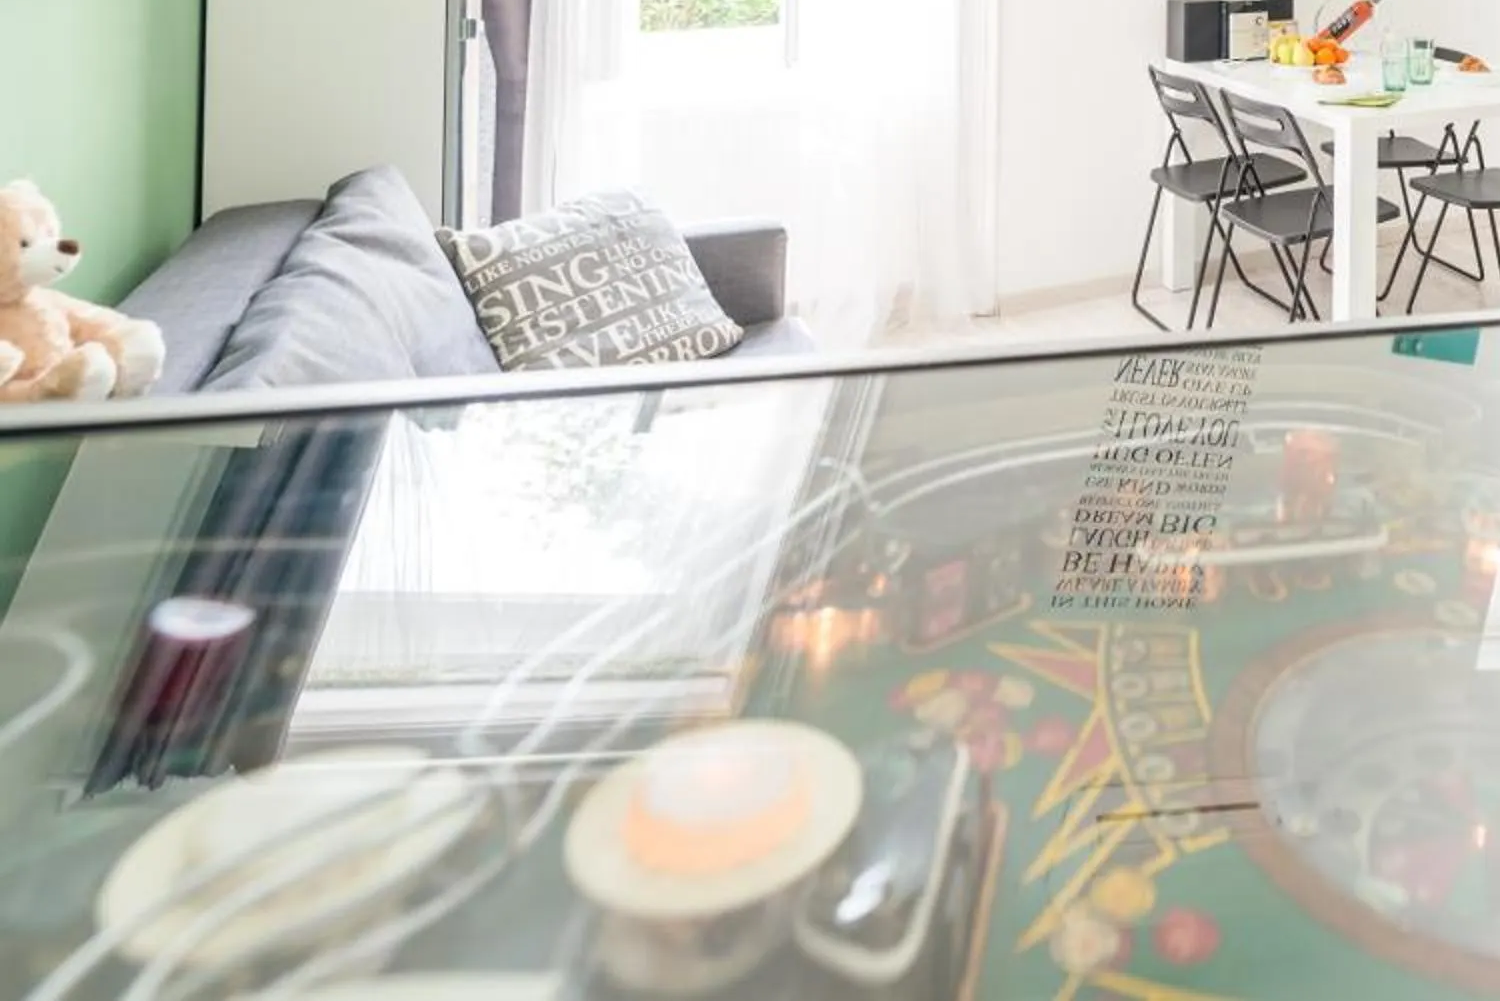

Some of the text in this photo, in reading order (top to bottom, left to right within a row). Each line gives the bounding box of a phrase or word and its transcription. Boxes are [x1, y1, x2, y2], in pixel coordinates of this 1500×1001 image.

[465, 259, 513, 294] LIKE
[477, 251, 610, 333] SING
[490, 258, 702, 362] LISTENING
